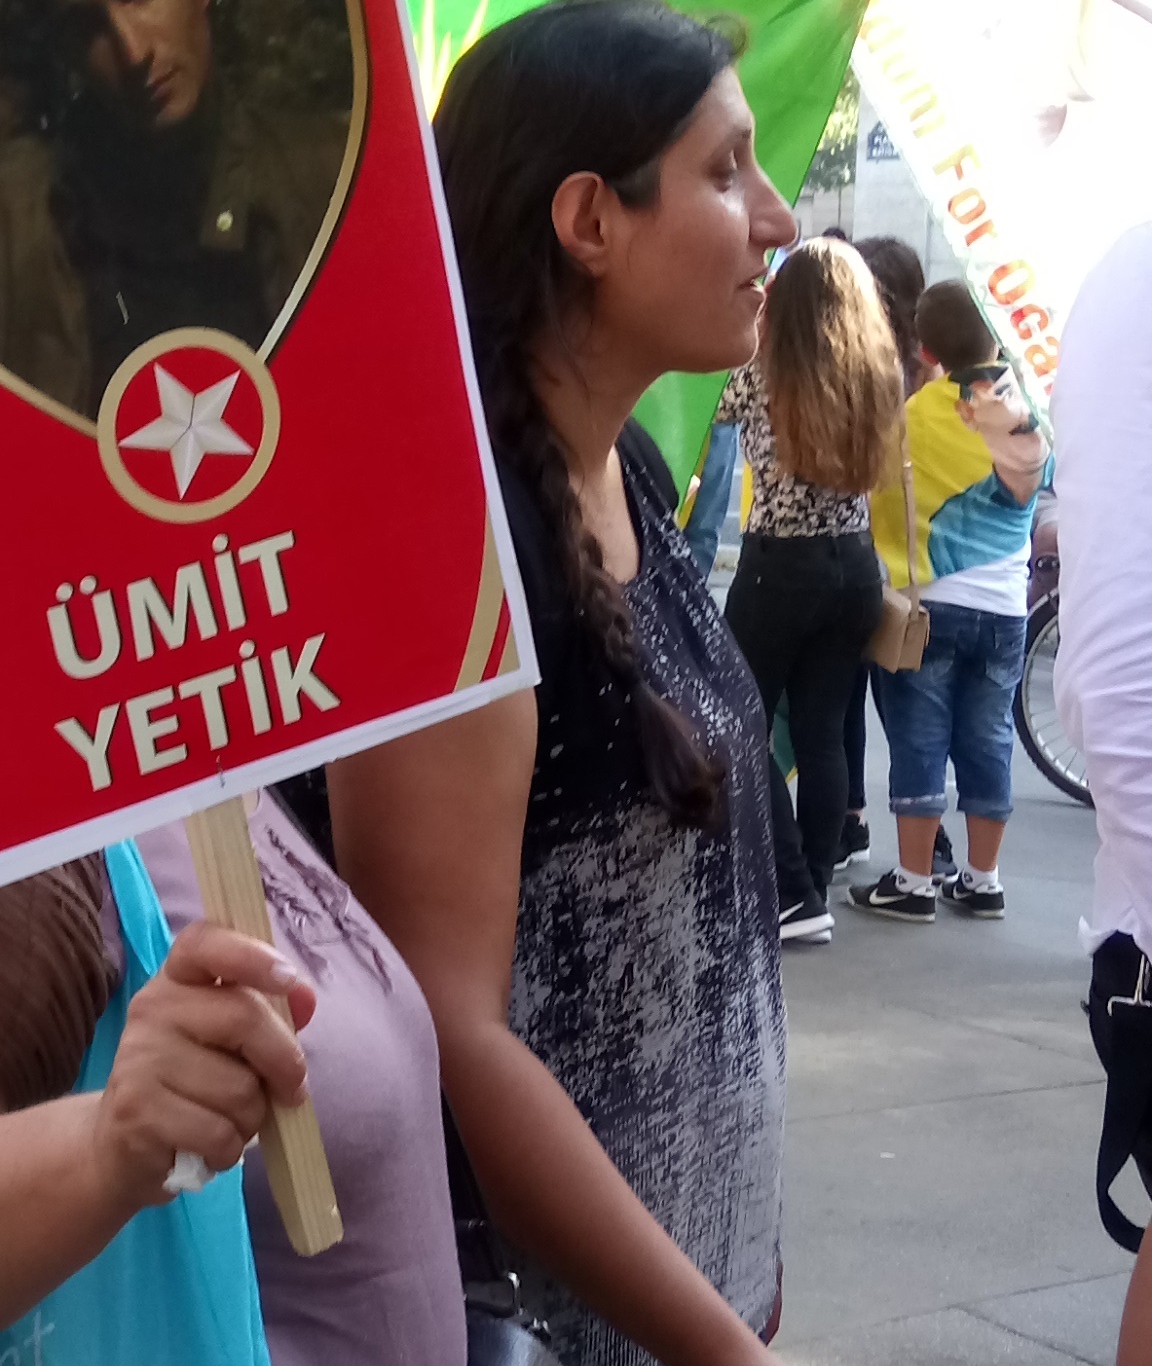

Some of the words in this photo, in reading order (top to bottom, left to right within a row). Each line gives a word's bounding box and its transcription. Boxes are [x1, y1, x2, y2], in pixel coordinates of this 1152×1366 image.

[931, 143, 999, 248] For
[986, 257, 1061, 397] Oca
[46, 529, 295, 680] ÜMİT
[54, 632, 341, 792] YETİK
